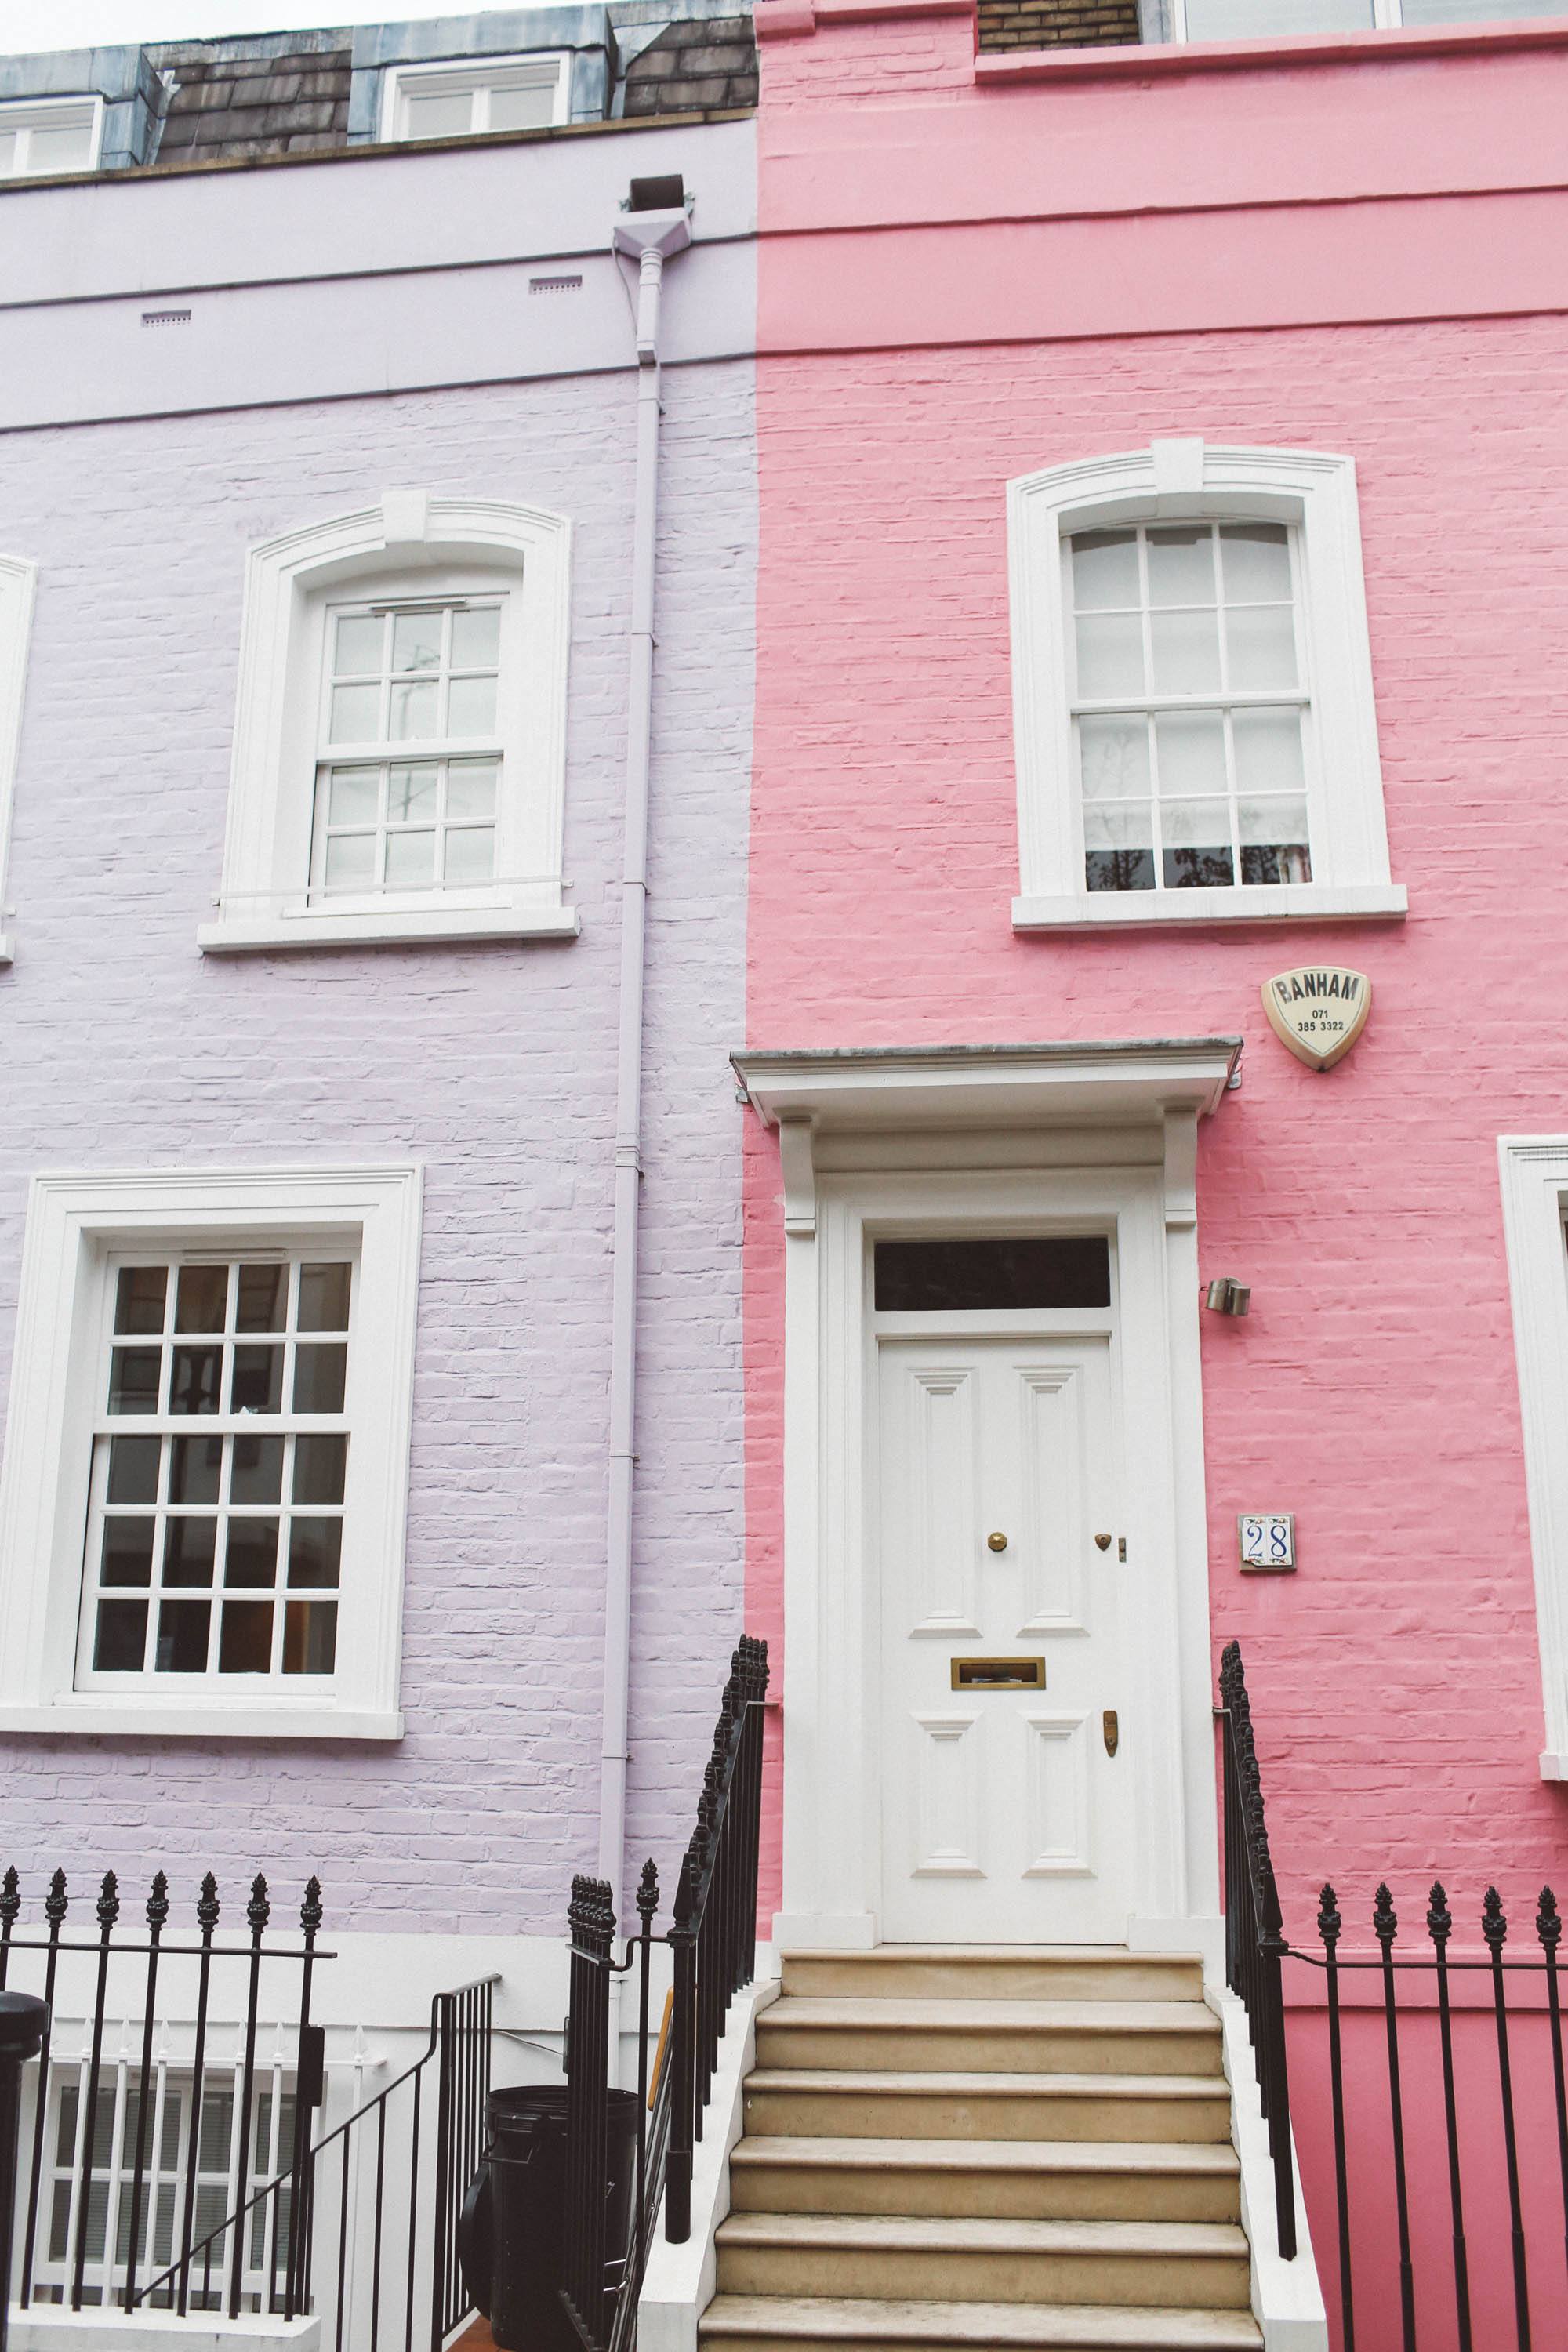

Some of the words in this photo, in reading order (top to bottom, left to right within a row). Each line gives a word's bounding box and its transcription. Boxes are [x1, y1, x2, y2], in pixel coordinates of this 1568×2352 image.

[1275, 973, 1359, 1004] BANHAM
[1312, 1010, 1328, 1019] 071
[1298, 1022, 1316, 1032] 385
[1320, 1022, 1344, 1031] 3322
[1247, 1525, 1287, 1558] 28
